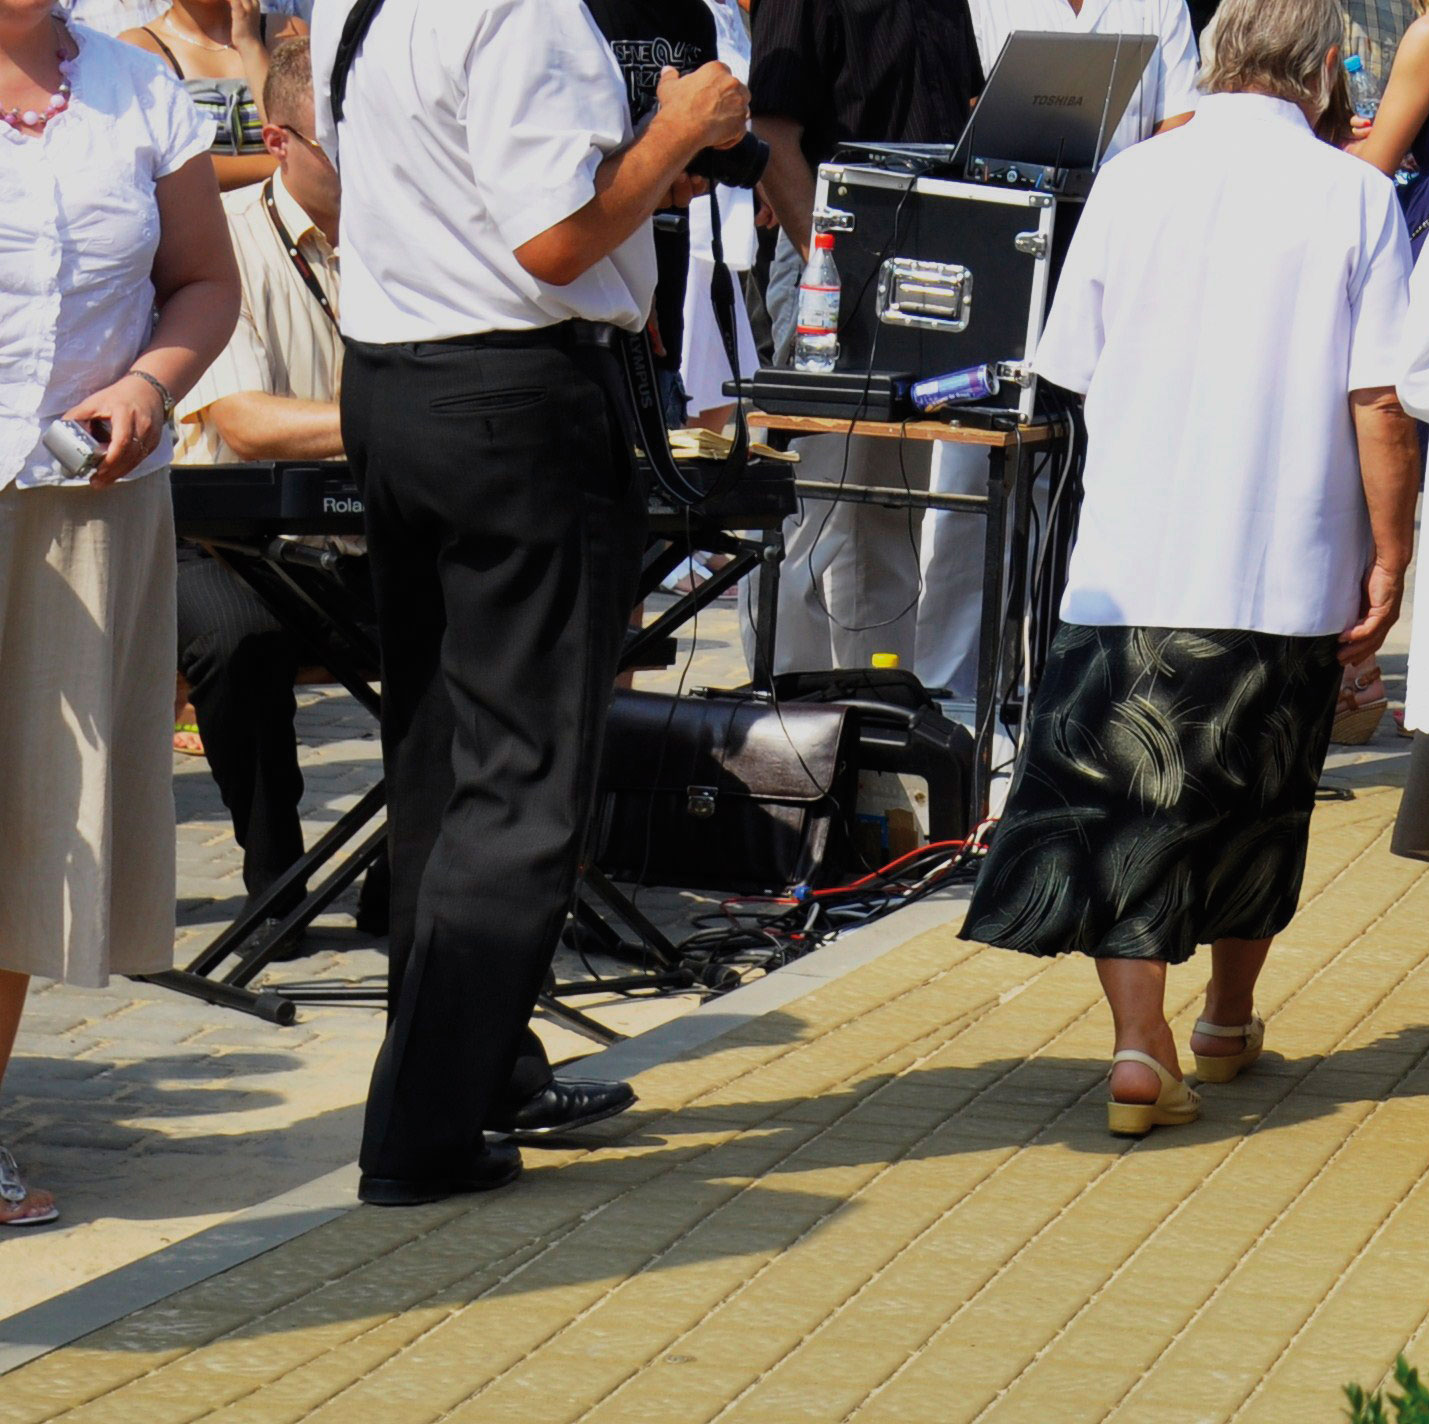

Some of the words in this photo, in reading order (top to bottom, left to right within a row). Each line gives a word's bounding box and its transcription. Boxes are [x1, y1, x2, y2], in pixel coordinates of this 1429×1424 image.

[1031, 95, 1083, 106] TOSHIBA
[628, 333, 654, 409] LYMPUS
[323, 496, 365, 513] Rola
